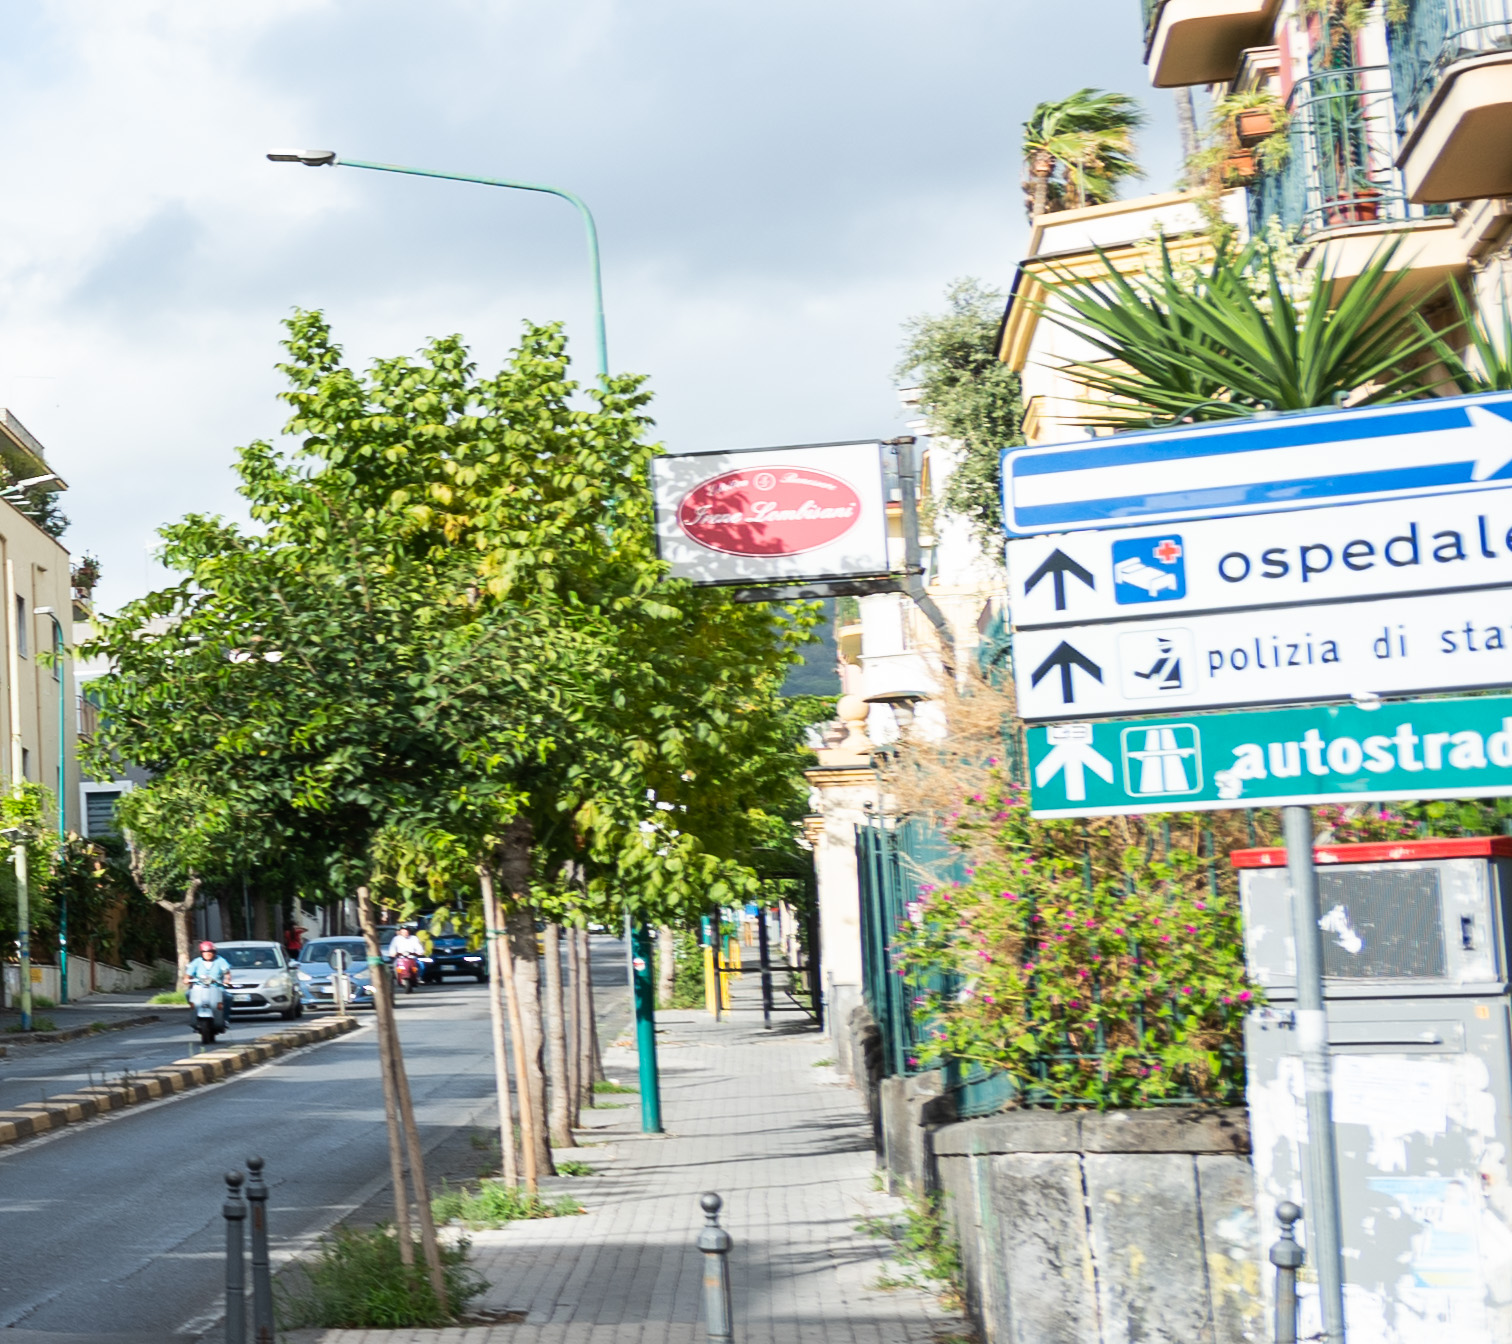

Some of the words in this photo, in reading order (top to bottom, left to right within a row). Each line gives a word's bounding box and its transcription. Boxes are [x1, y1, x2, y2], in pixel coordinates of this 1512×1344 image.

[1218, 514, 1512, 583] ospedal
[1208, 633, 1341, 678] polizia
[1373, 624, 1408, 660] di
[1441, 621, 1512, 654] sta
